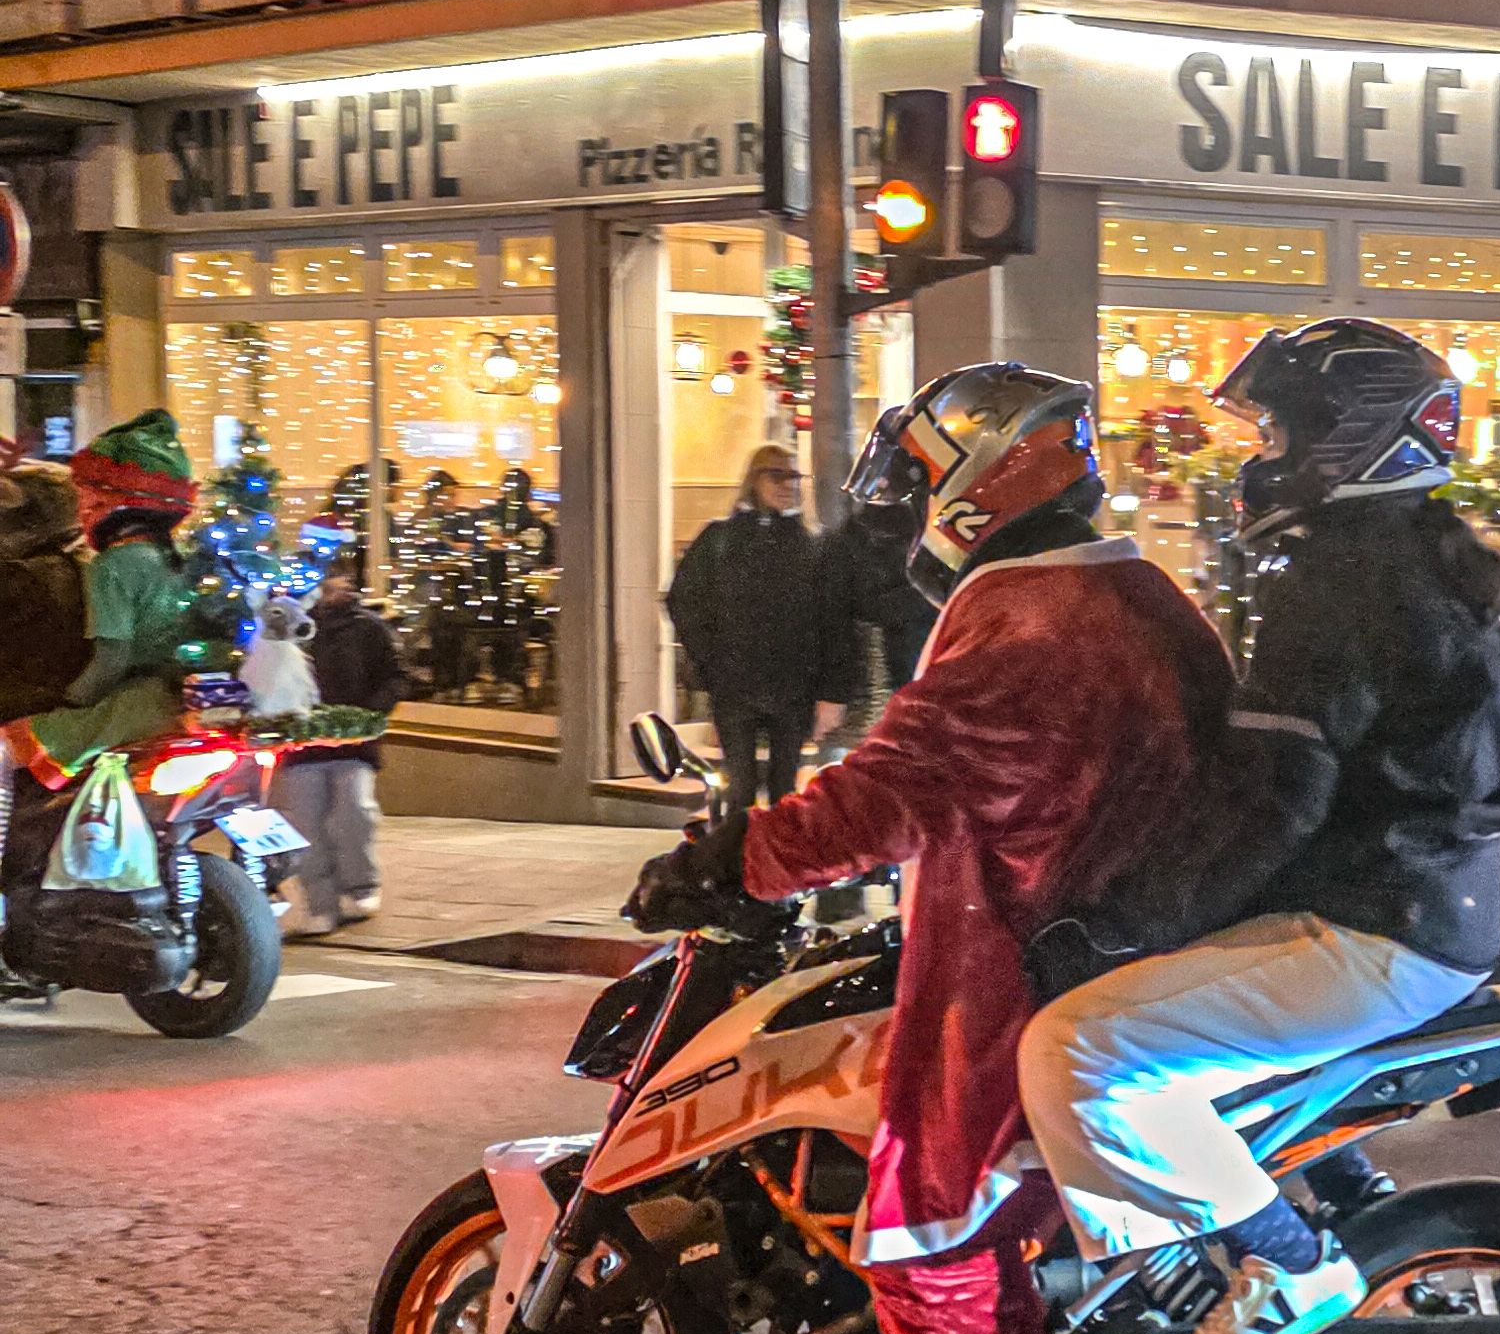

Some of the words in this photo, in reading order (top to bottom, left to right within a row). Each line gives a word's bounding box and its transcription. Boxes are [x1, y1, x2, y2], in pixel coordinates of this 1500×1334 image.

[167, 104, 271, 215] SALE
[293, 99, 318, 208] E
[338, 85, 460, 205] PEPE
[577, 125, 719, 188] Pizzería
[1177, 52, 1389, 182] SALE
[1420, 67, 1466, 188] E
[634, 1056, 741, 1117] 390
